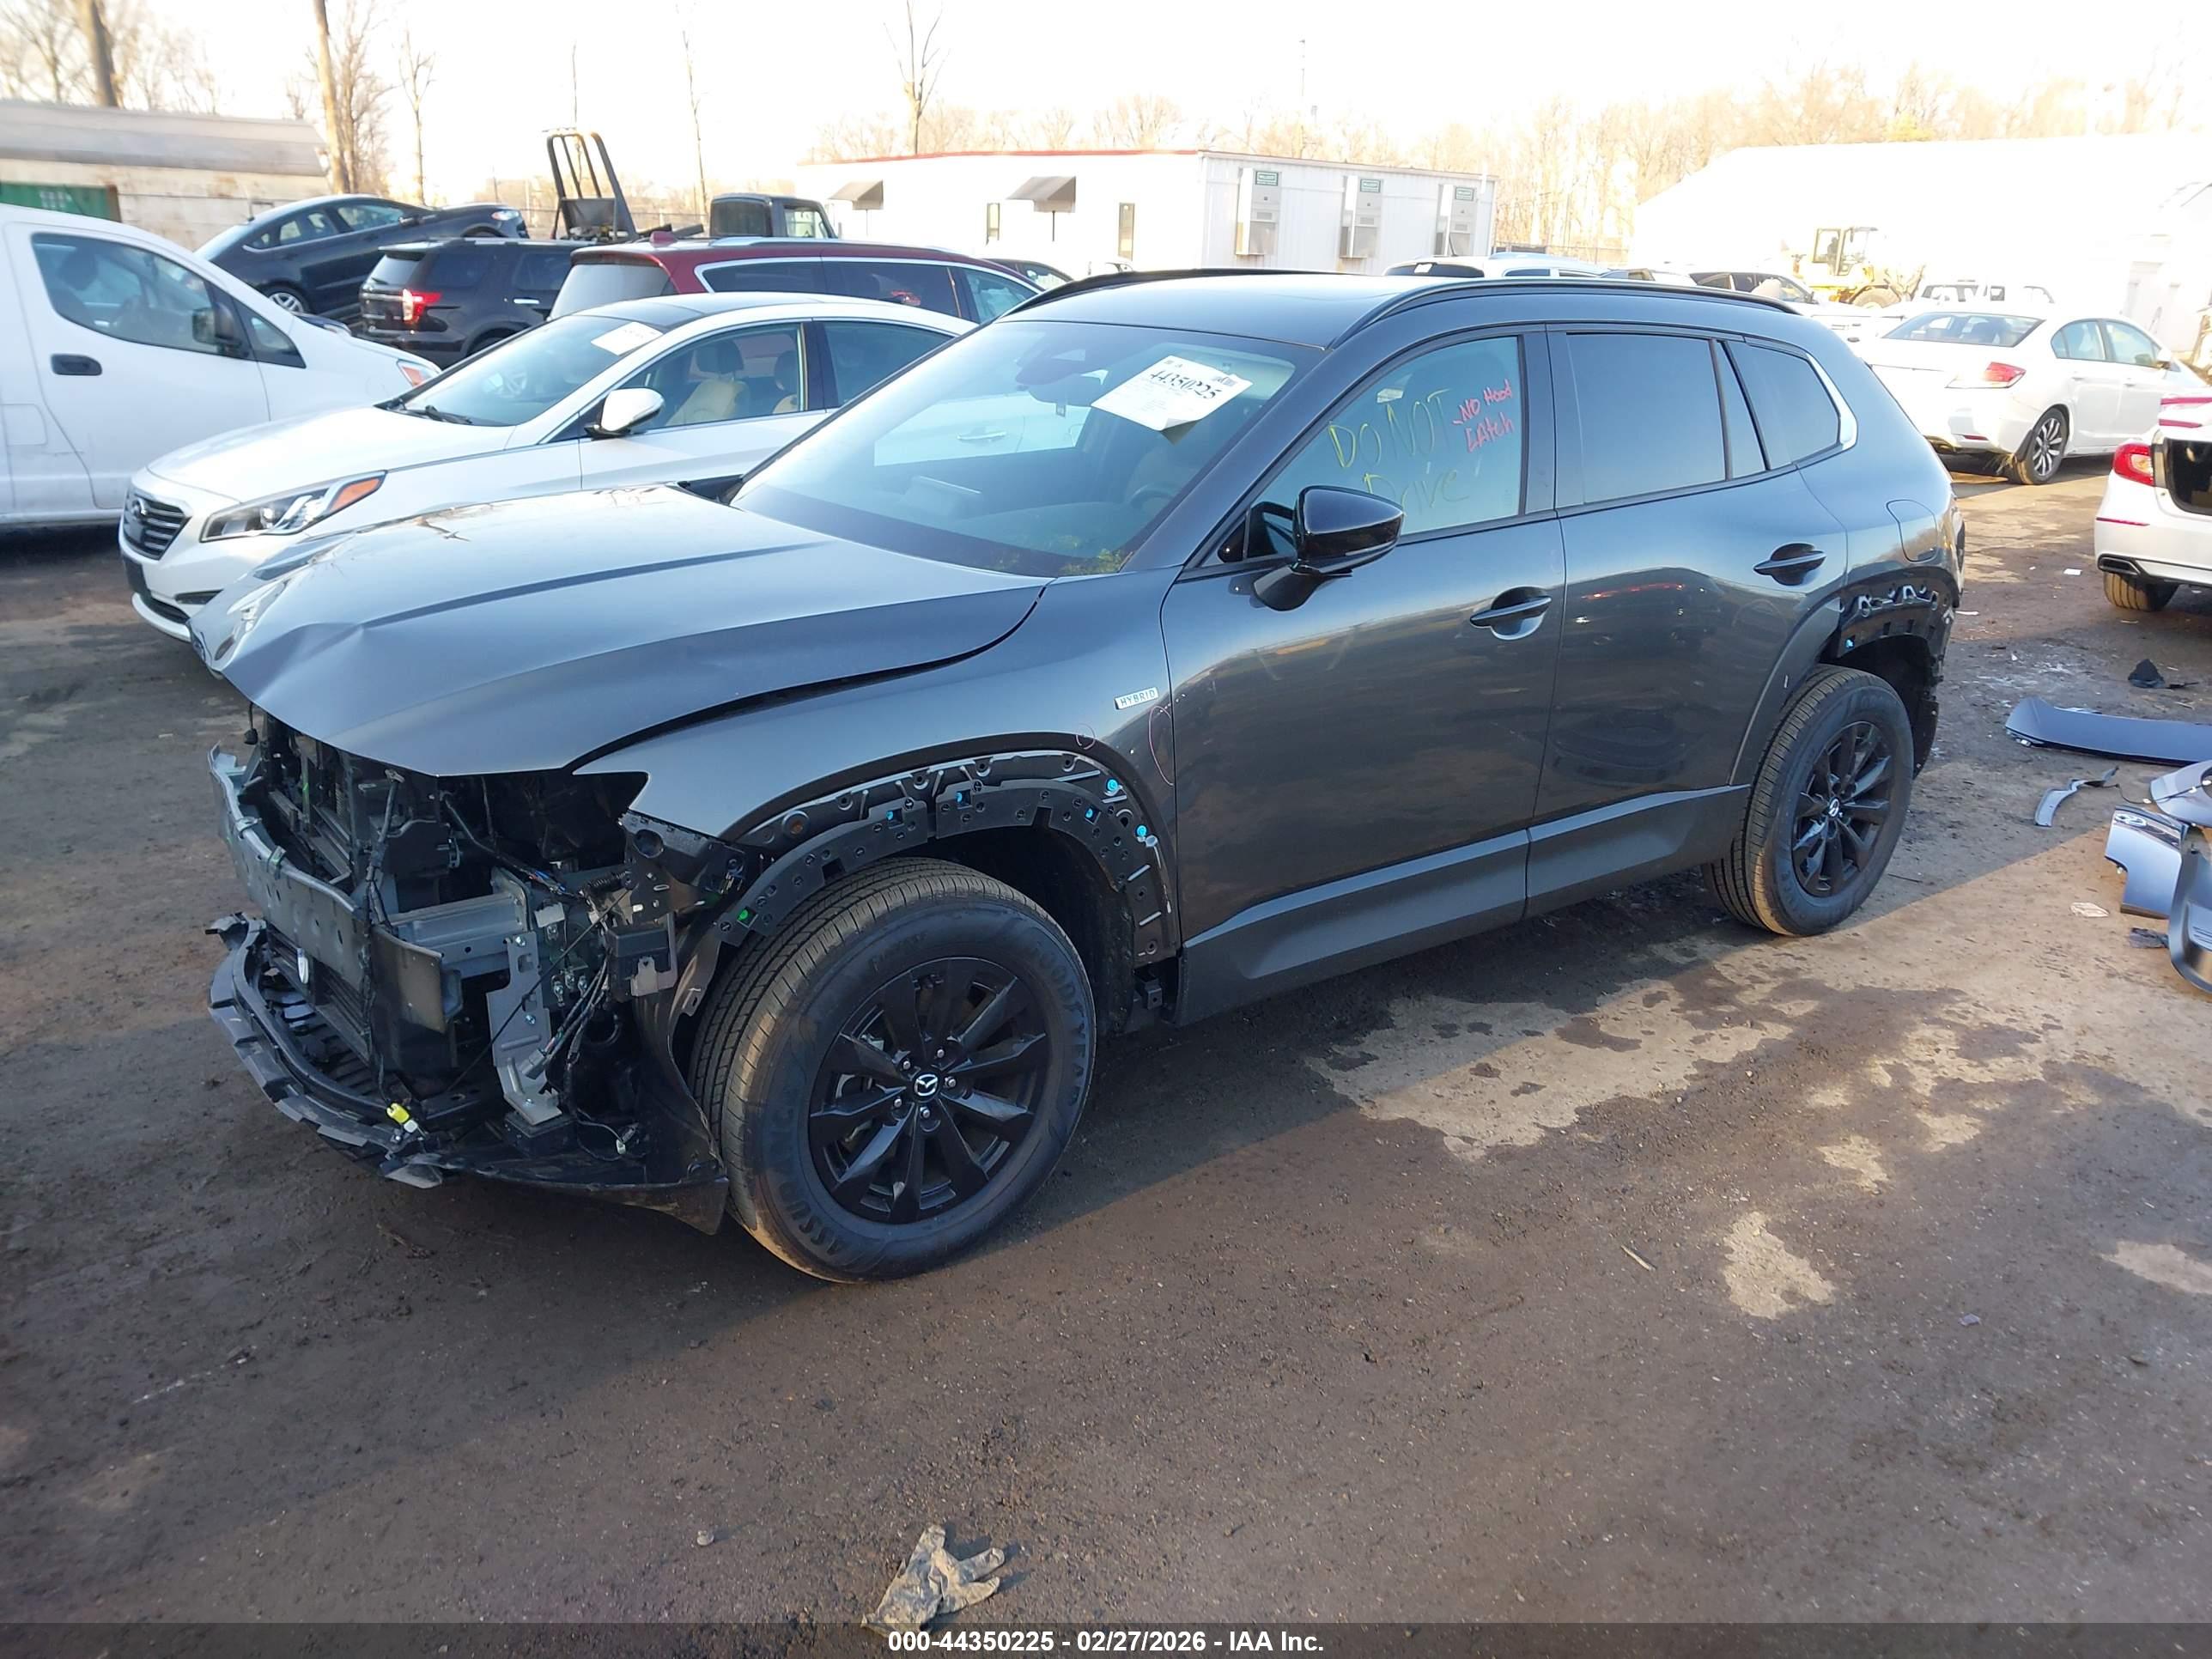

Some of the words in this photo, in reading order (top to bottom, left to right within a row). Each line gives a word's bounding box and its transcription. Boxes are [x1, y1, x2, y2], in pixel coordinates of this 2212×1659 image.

[1151, 371, 1222, 398] 44350225
[1328, 422, 1382, 468] DO
[1386, 387, 1451, 459] NOT
[1120, 690, 1157, 707] HYBRID
